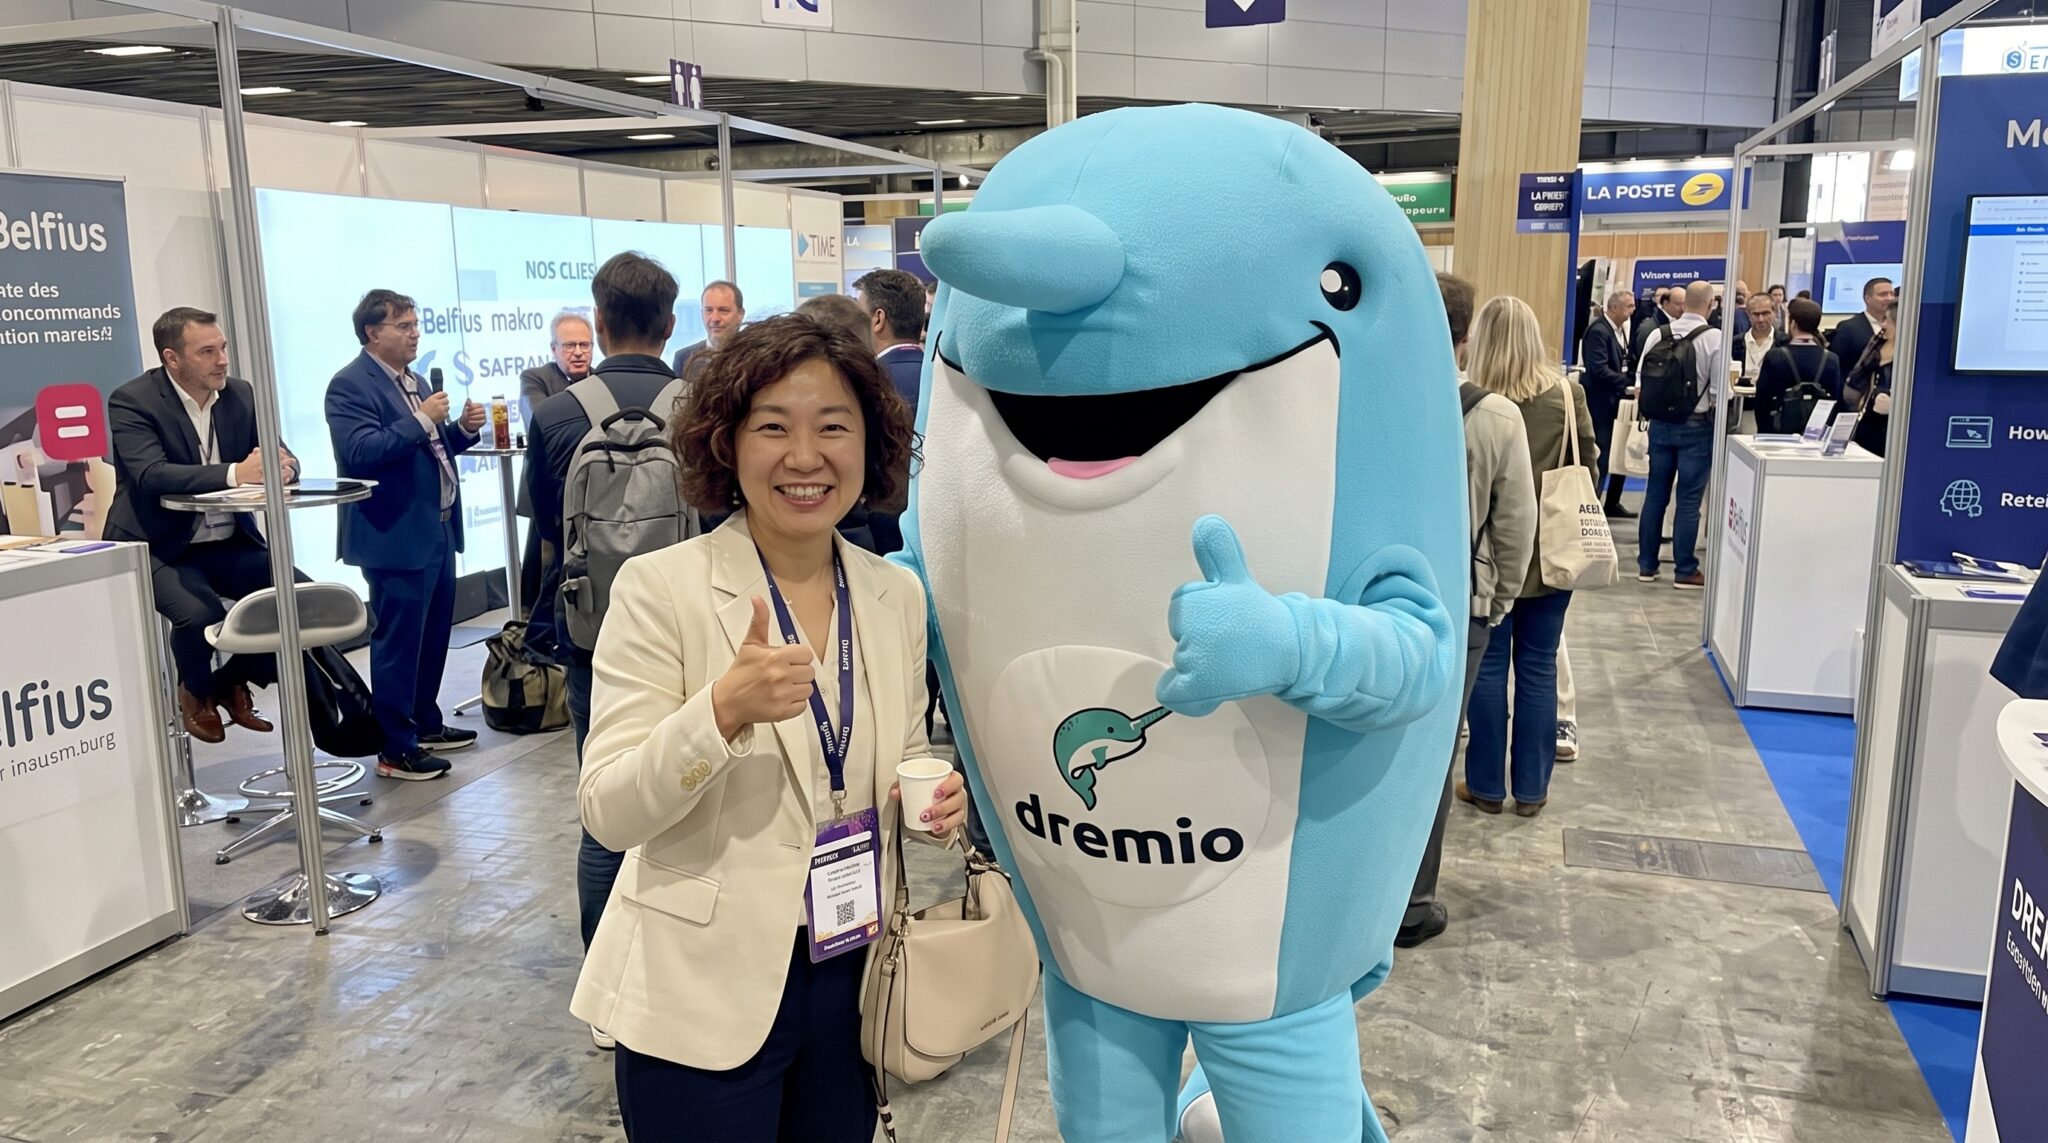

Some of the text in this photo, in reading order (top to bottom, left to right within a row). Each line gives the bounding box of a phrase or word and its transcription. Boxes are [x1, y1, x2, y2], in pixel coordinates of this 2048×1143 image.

[2006, 118, 2048, 149] M
[1587, 186, 1611, 200] LA
[1615, 183, 1676, 199] POSTE
[809, 235, 836, 257] TIME
[525, 260, 556, 279] NOS
[29, 282, 60, 298] des
[423, 307, 483, 334] Belfius
[491, 306, 544, 332] makro
[0, 679, 112, 748] lfius
[1015, 793, 1244, 865] dremio
